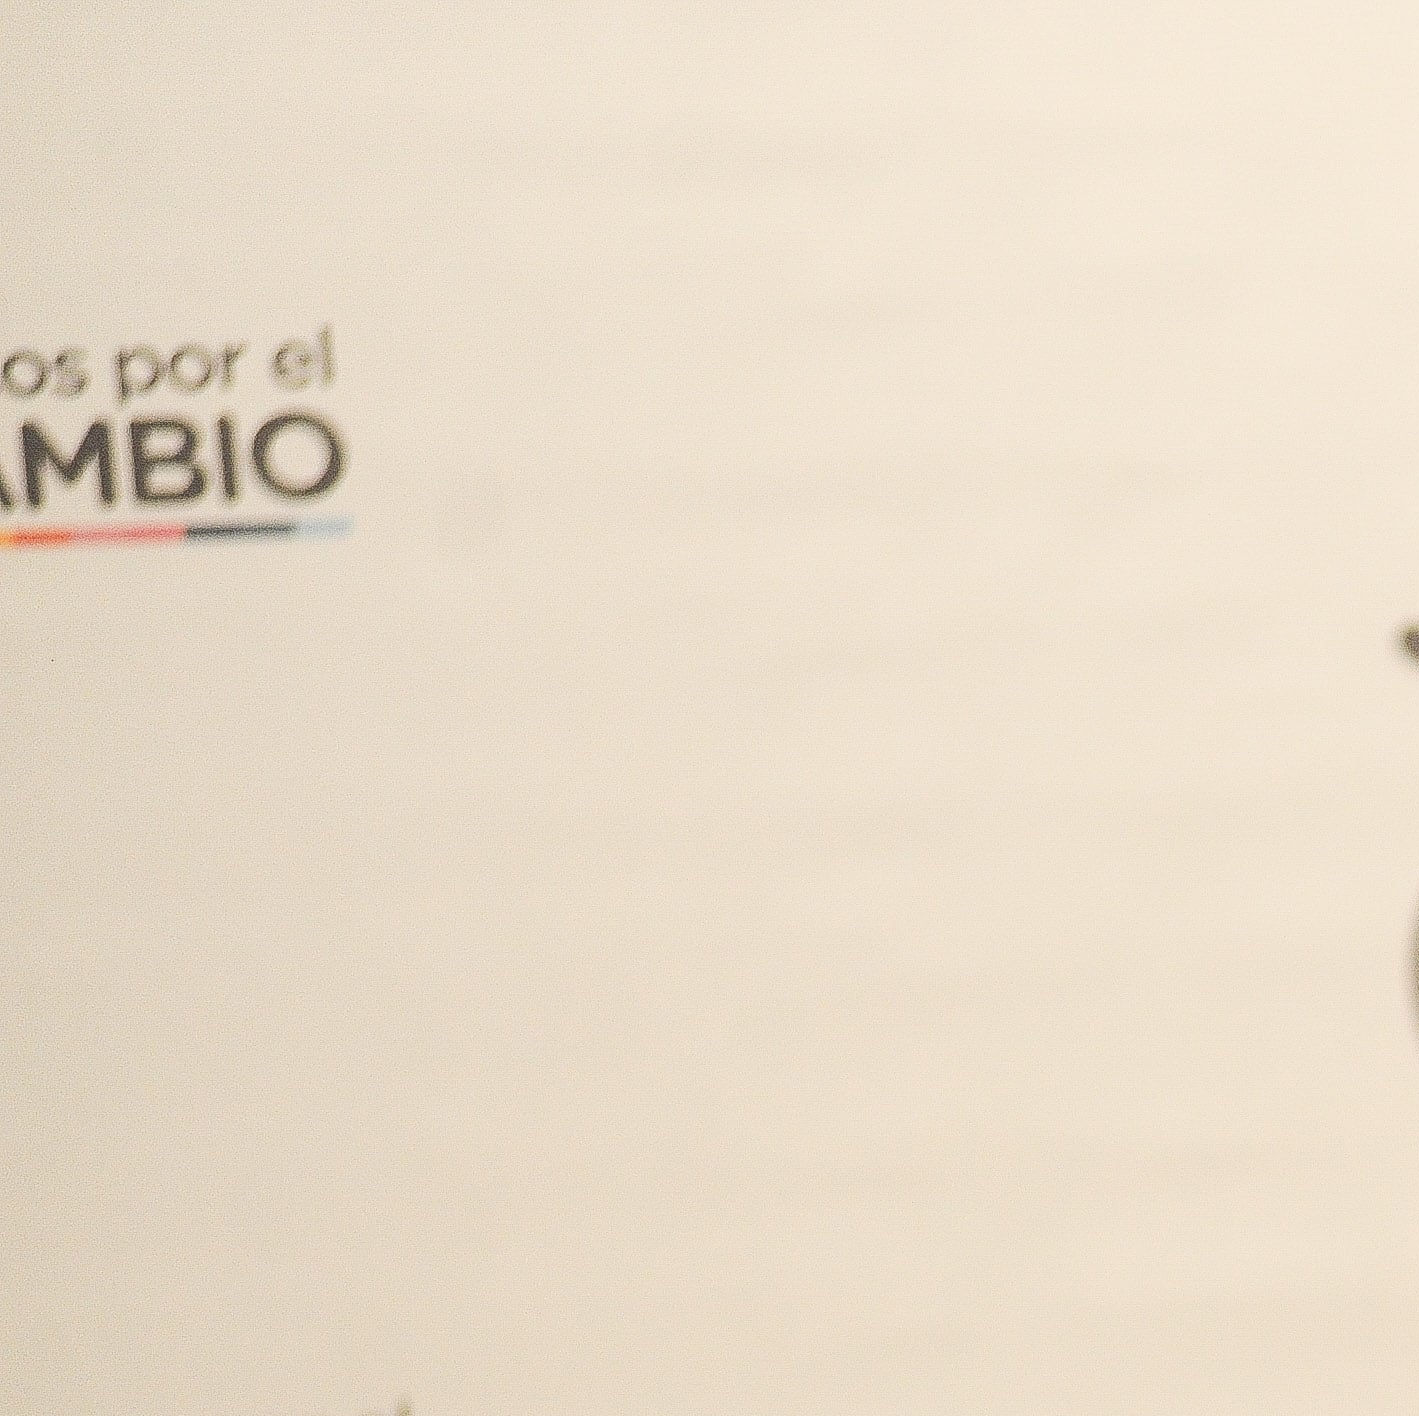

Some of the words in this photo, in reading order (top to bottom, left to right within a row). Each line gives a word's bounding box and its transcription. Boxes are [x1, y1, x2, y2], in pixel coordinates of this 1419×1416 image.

[115, 340, 247, 405] por
[269, 322, 337, 390] el
[0, 408, 347, 508] MBIO
